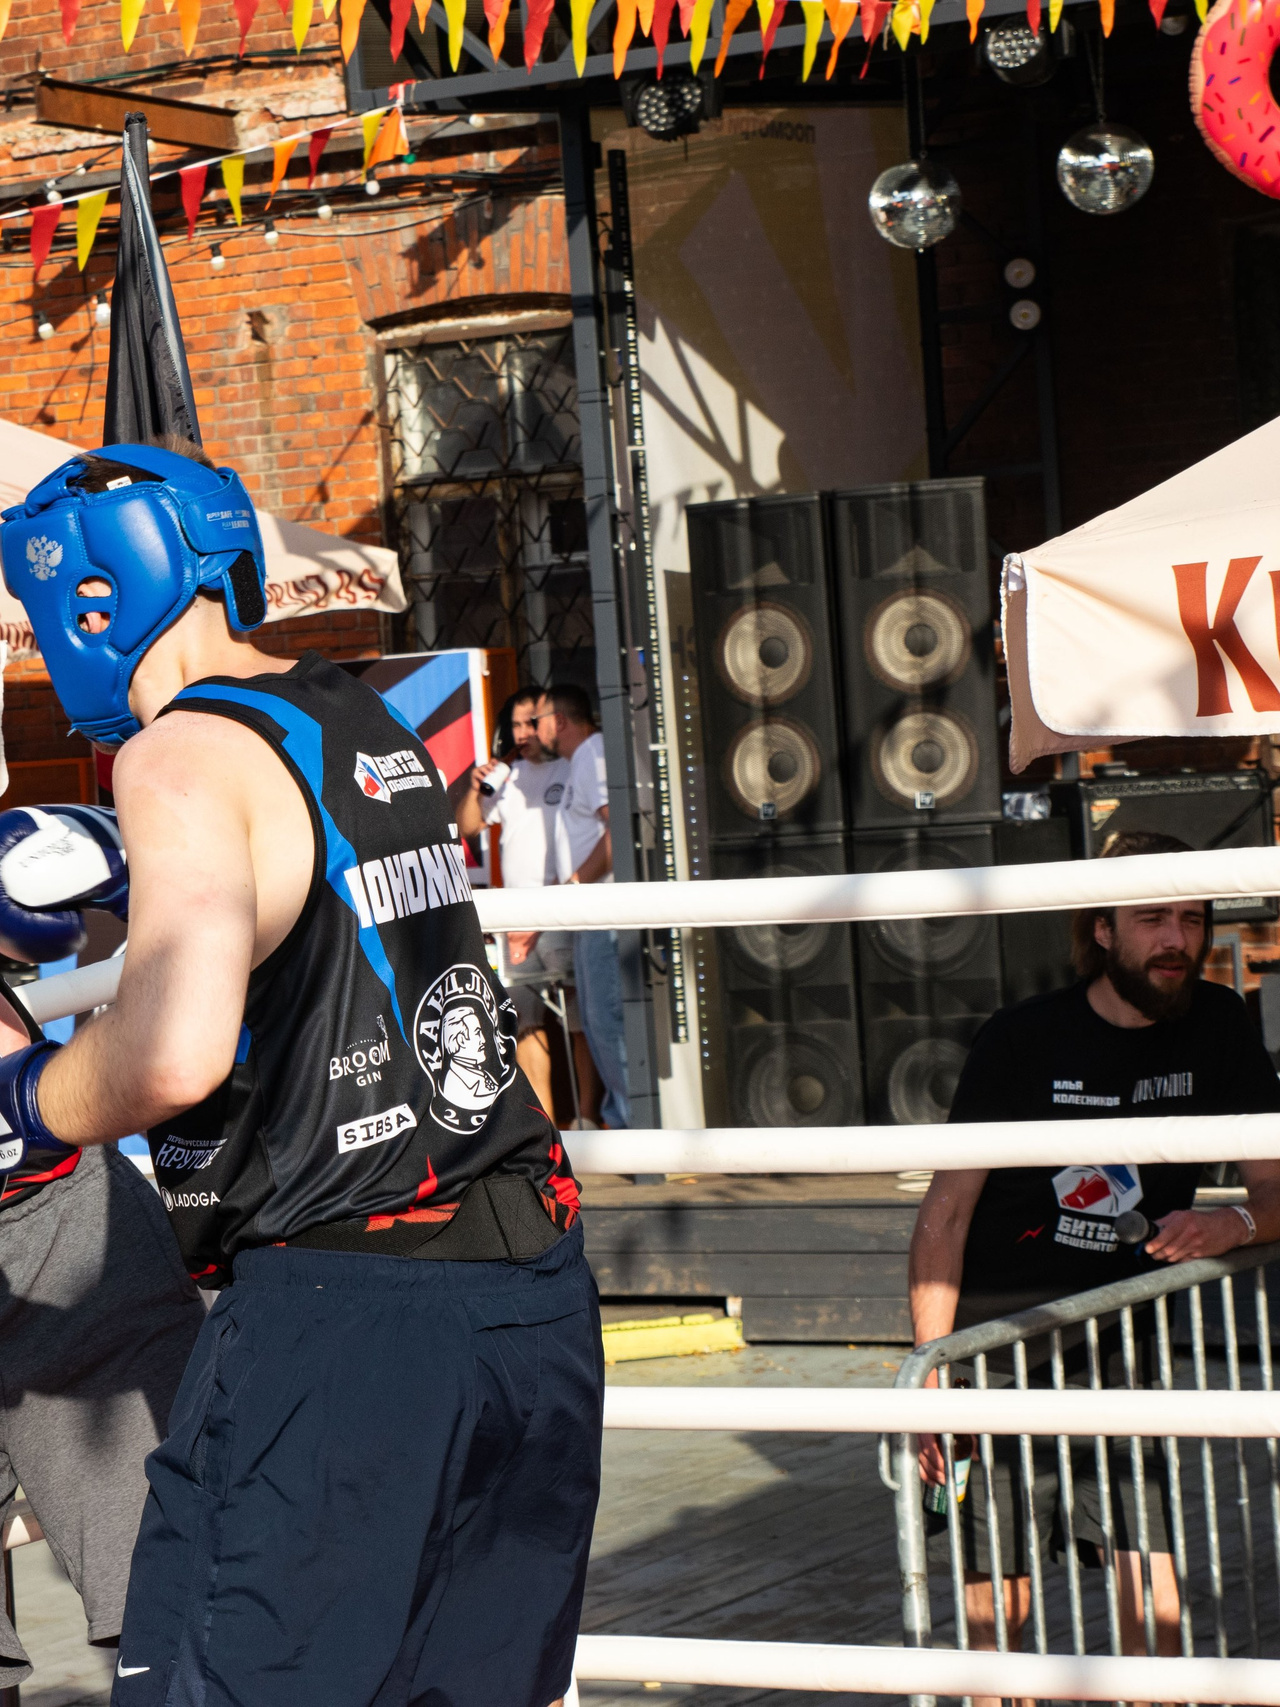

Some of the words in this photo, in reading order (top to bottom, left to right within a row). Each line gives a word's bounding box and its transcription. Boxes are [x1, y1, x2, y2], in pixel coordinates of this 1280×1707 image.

[329, 1040, 392, 1080] BROOM
[356, 1071, 382, 1087] GIN
[1053, 1080, 1083, 1091] ИЛЬЯ
[1053, 1093, 1121, 1107] КОЛЕСНИКОВ
[343, 1112, 412, 1146] SIBSA
[172, 1190, 221, 1208] LADOGA
